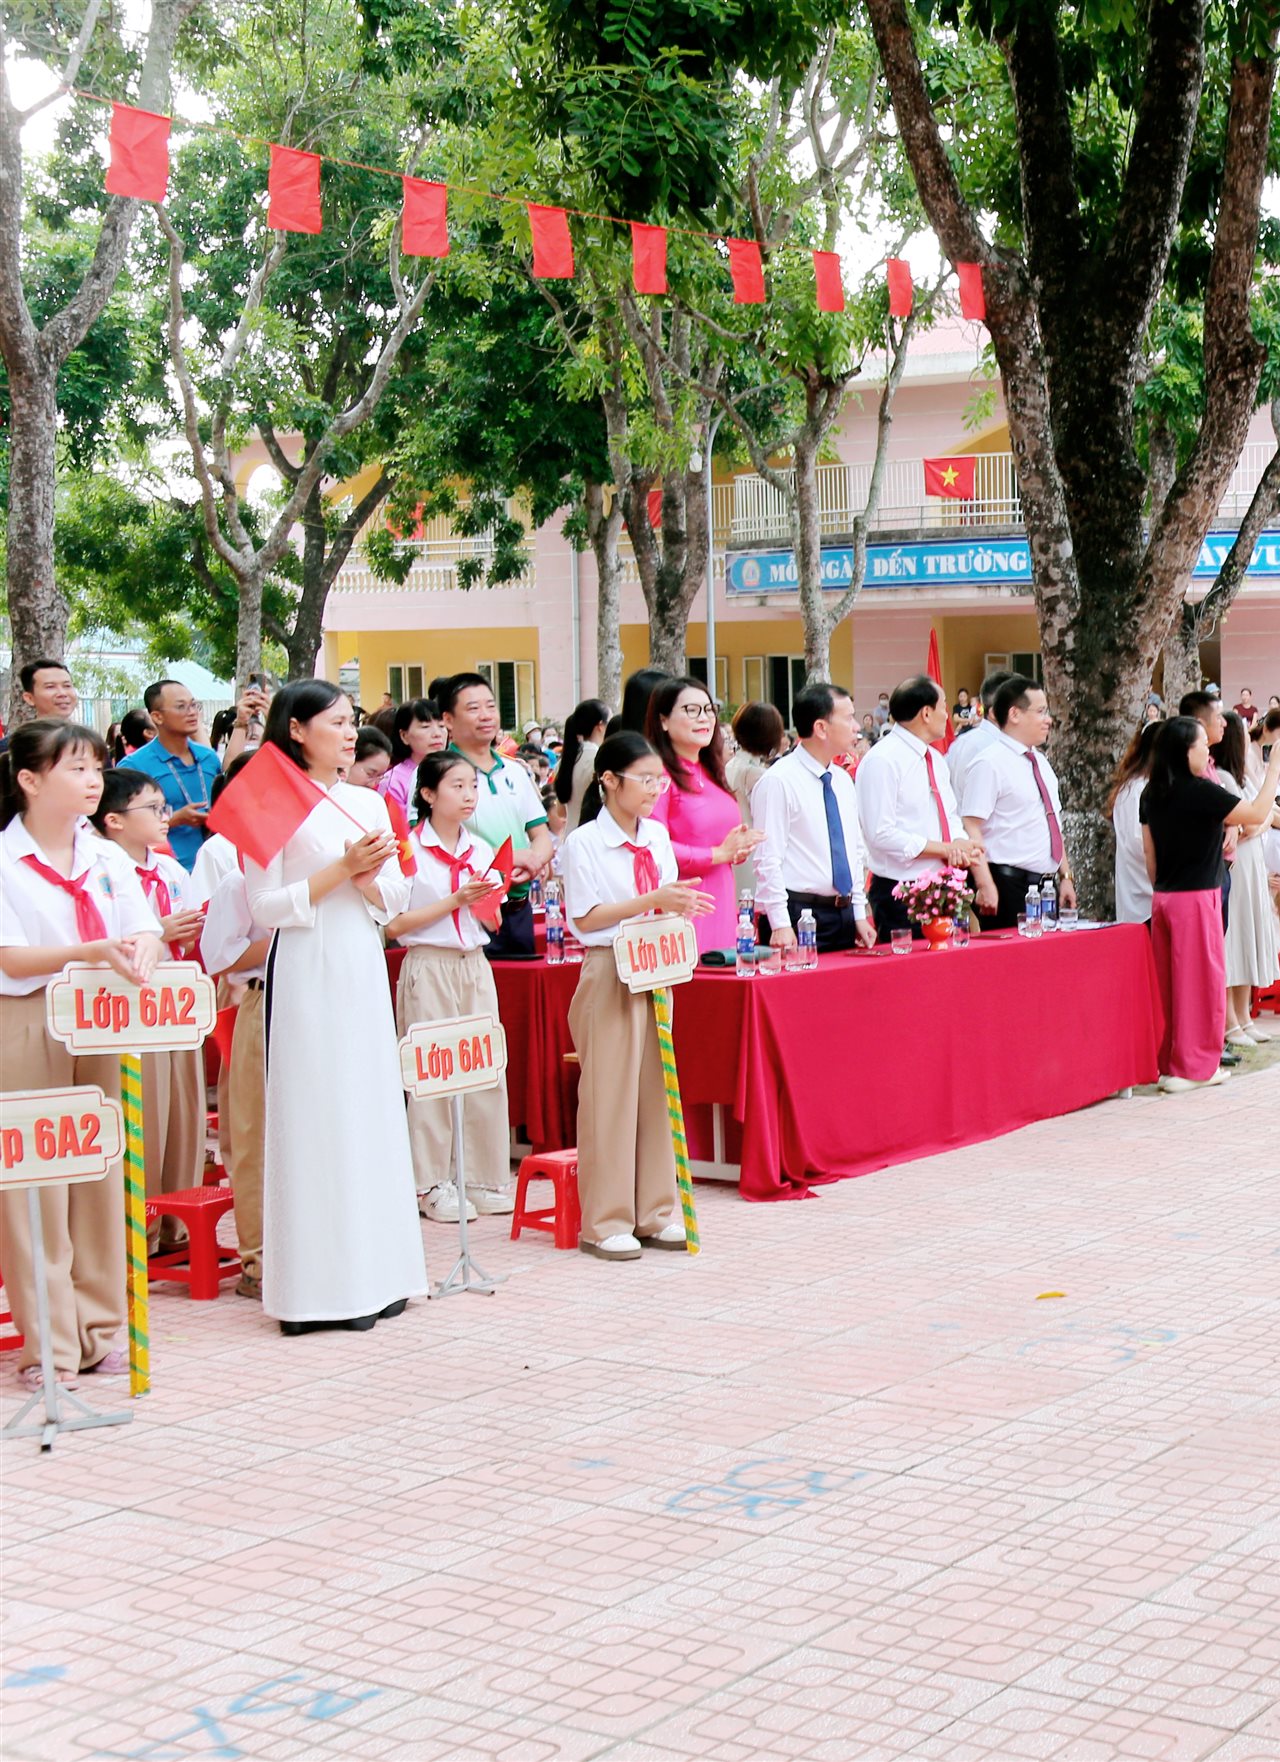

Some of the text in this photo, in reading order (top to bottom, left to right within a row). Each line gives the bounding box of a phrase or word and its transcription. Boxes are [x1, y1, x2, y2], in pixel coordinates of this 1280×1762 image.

[923, 546, 1027, 574] TRƯỜNG
[627, 932, 686, 973] Lớp 6A1
[75, 987, 196, 1033] Lớp 6A2
[415, 1034, 493, 1081] Lớp 6A1
[34, 1113, 102, 1161] 6A2
